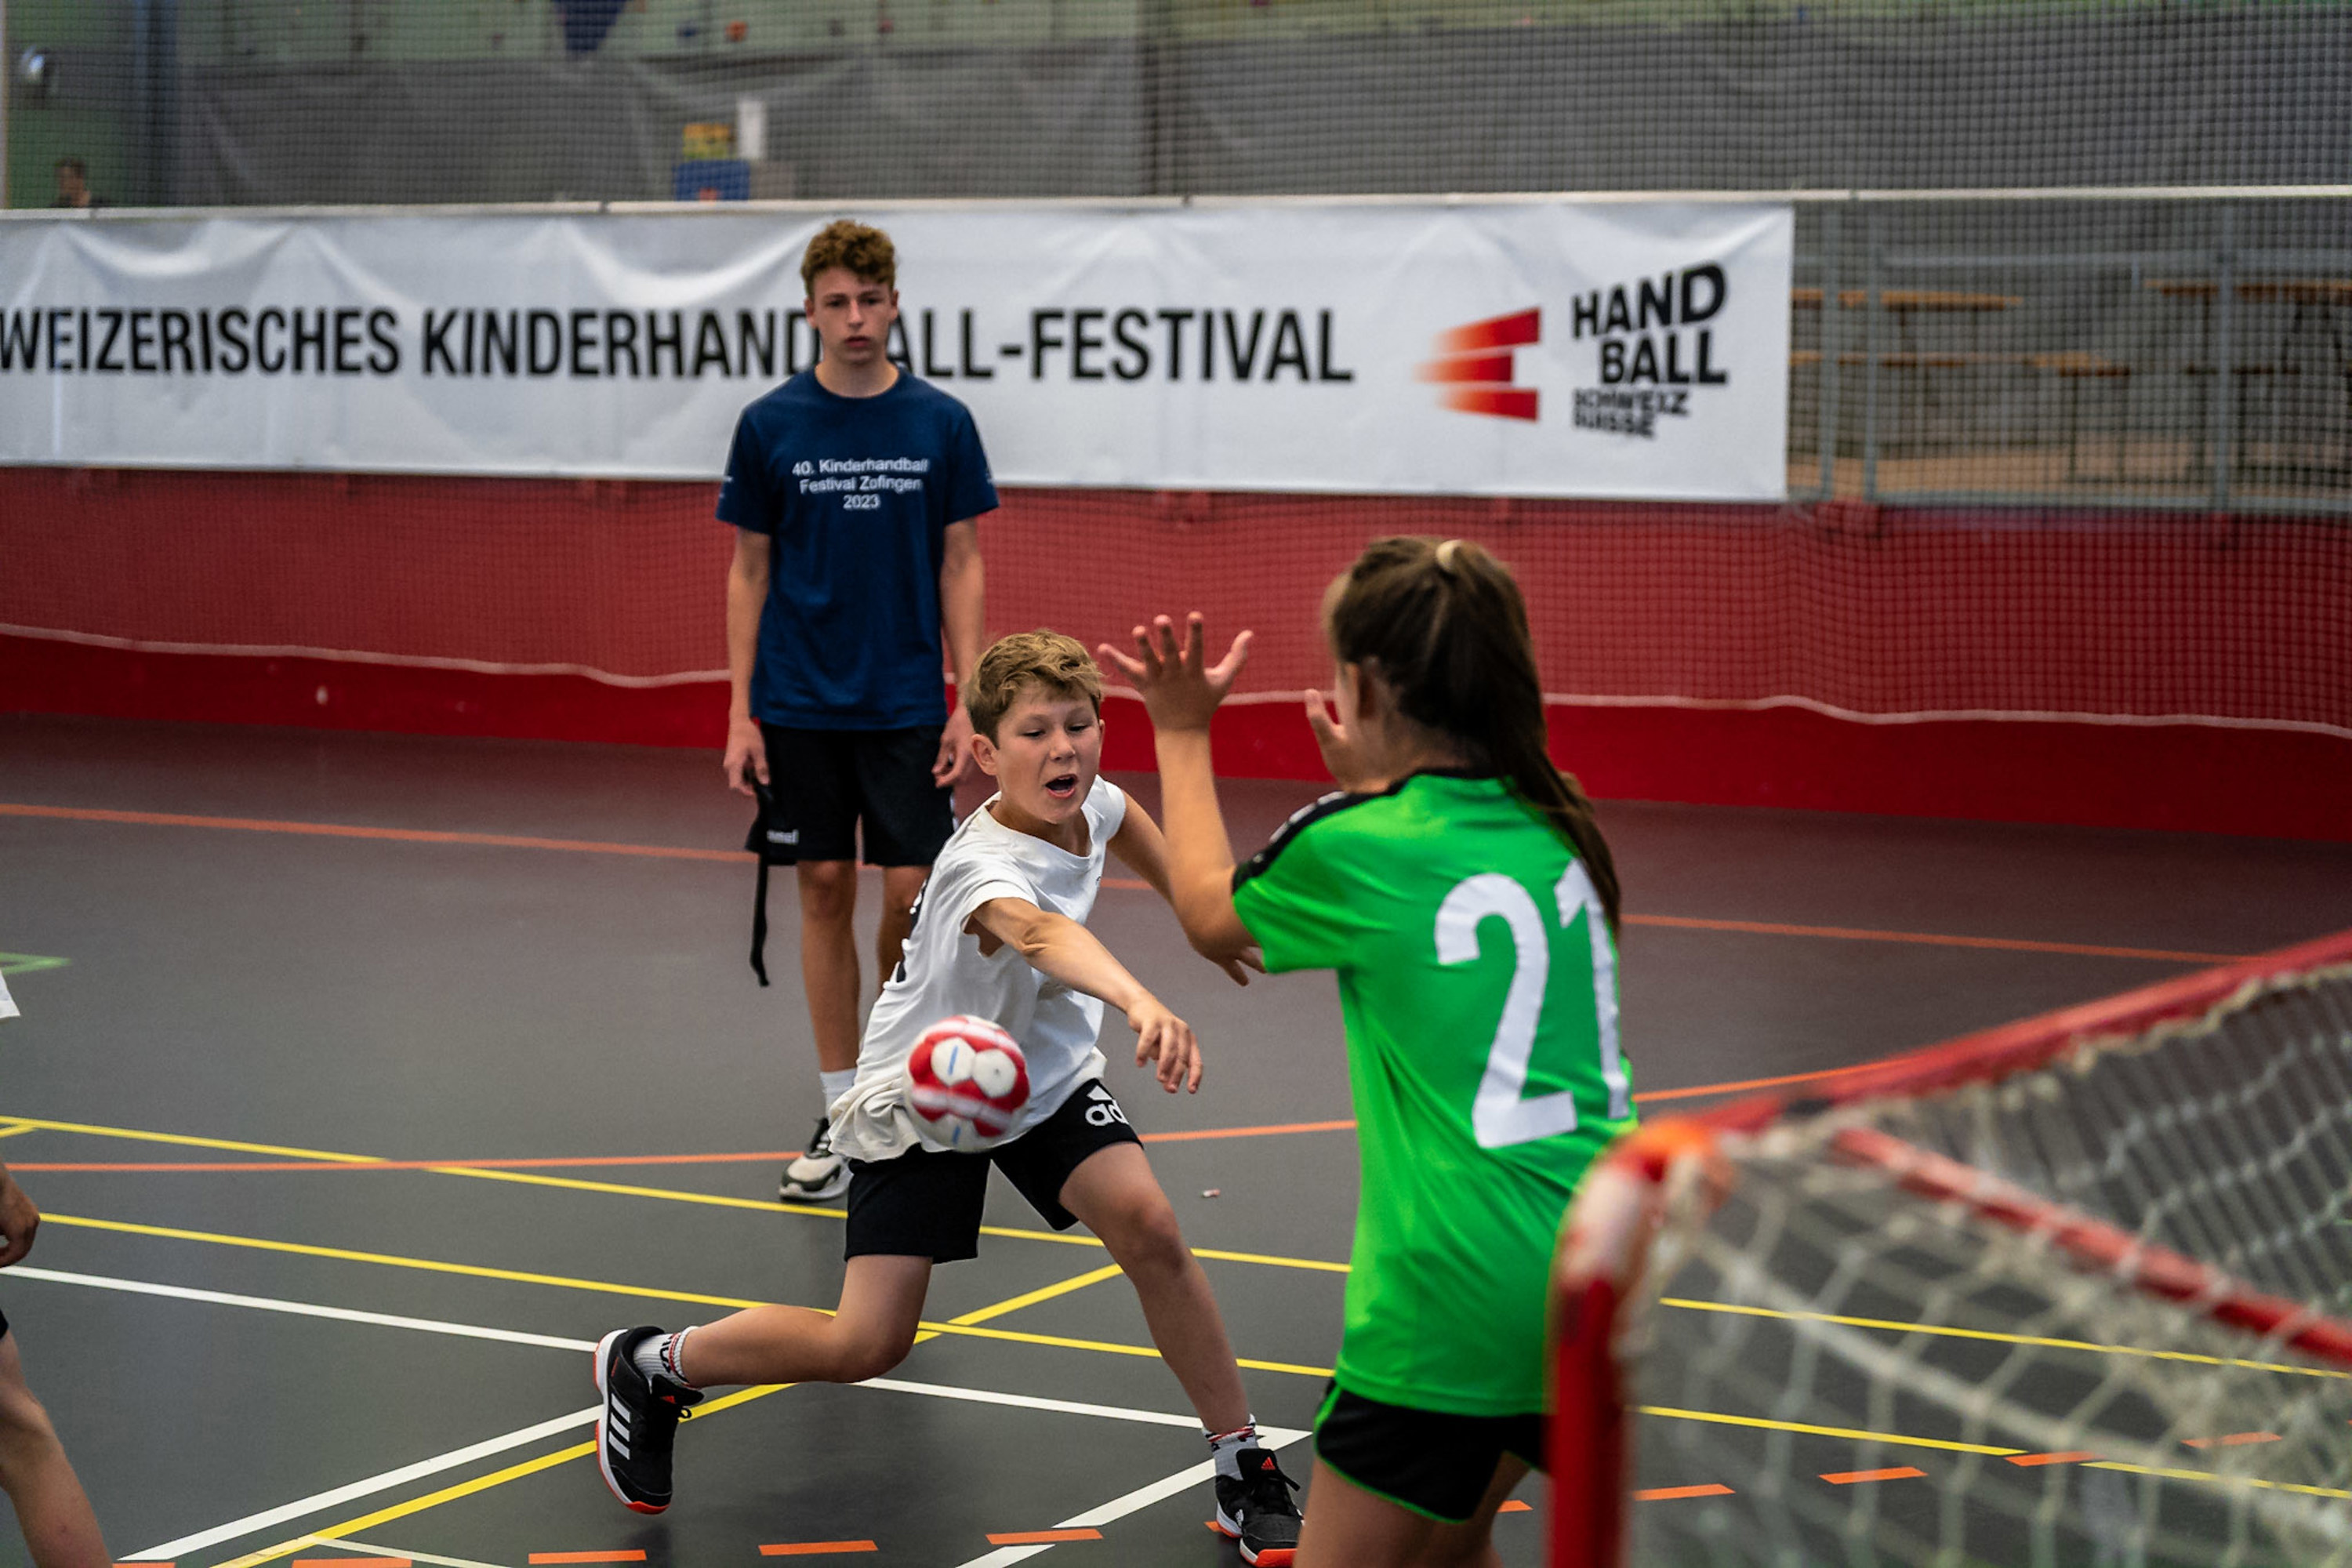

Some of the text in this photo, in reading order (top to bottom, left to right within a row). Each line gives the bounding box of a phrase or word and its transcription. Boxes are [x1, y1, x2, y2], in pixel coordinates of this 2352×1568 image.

[1572, 262, 1728, 339] HAND
[0, 307, 1354, 383] WEIZERISCHES KINDERHANDALL-FESTIVAL
[1600, 327, 1728, 386] BALL
[792, 457, 930, 476] 40. Kinderhandball
[800, 474, 923, 495] Festival Zofingen
[843, 494, 881, 510] 2023
[1434, 858, 1630, 1149] 21
